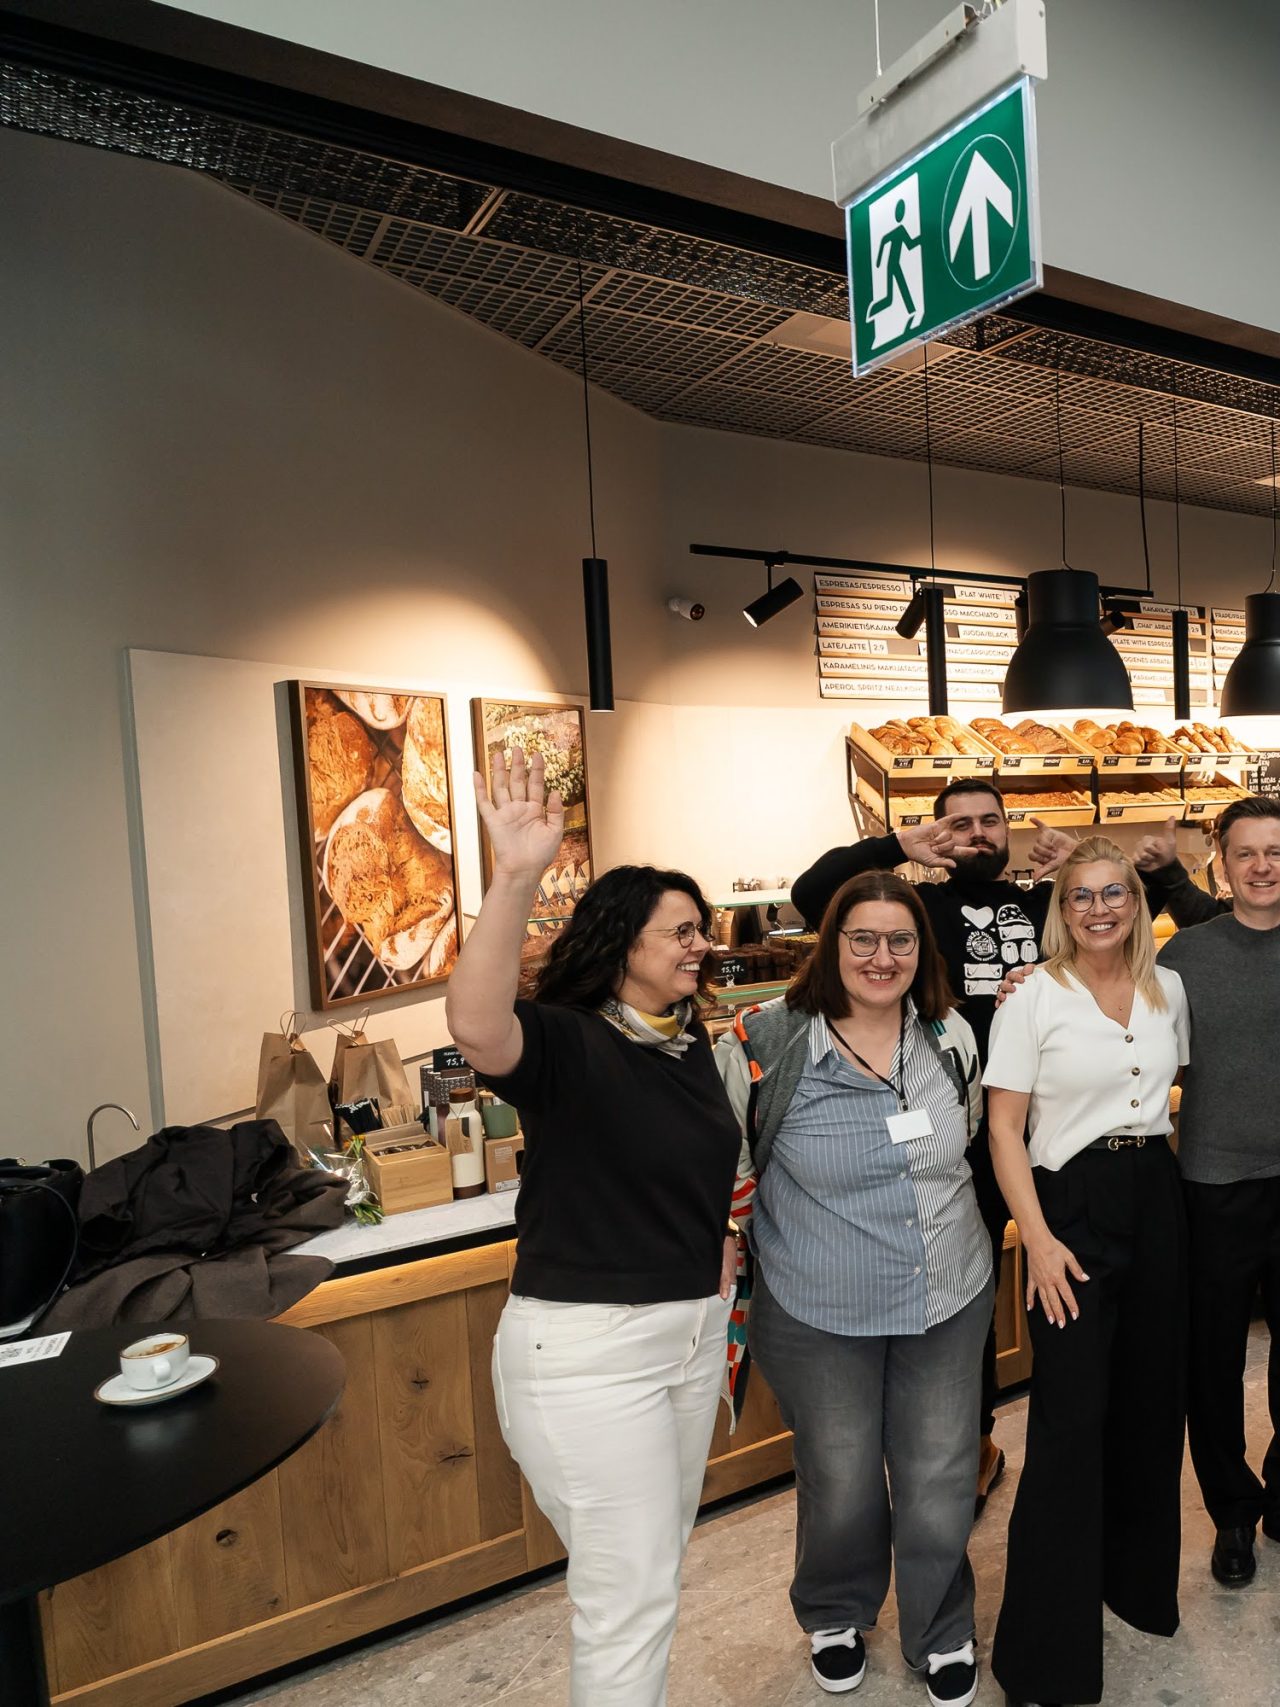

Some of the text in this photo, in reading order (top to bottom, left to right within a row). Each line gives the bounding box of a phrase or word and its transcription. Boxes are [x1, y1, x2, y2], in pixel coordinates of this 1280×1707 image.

[819, 579, 901, 592] ESPRESAS/ESPRESSO
[820, 600, 860, 611] ESPRESAS
[862, 602, 872, 611] SU
[874, 604, 898, 612] PIENO
[960, 610, 999, 619] MACCHIATO
[822, 642, 866, 650] LATE/LATTE
